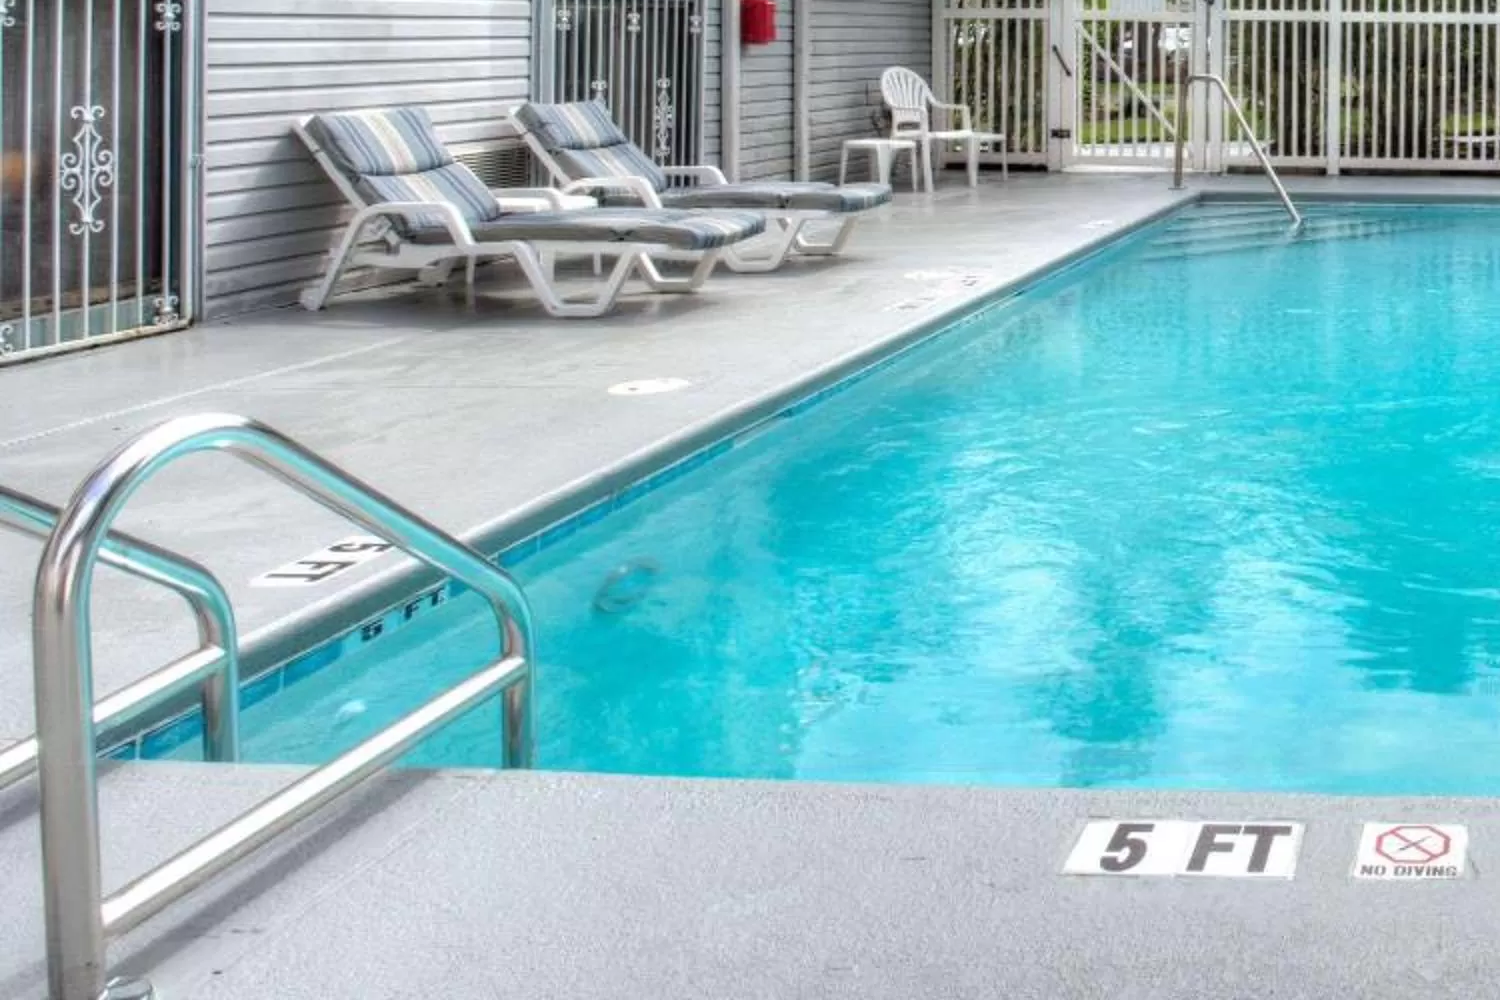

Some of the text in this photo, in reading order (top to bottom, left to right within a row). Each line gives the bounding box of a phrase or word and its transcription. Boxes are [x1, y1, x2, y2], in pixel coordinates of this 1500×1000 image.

[264, 542, 394, 582] 5 FT
[1099, 823, 1292, 873] 5 FT
[1360, 864, 1457, 877] NO DIVING
